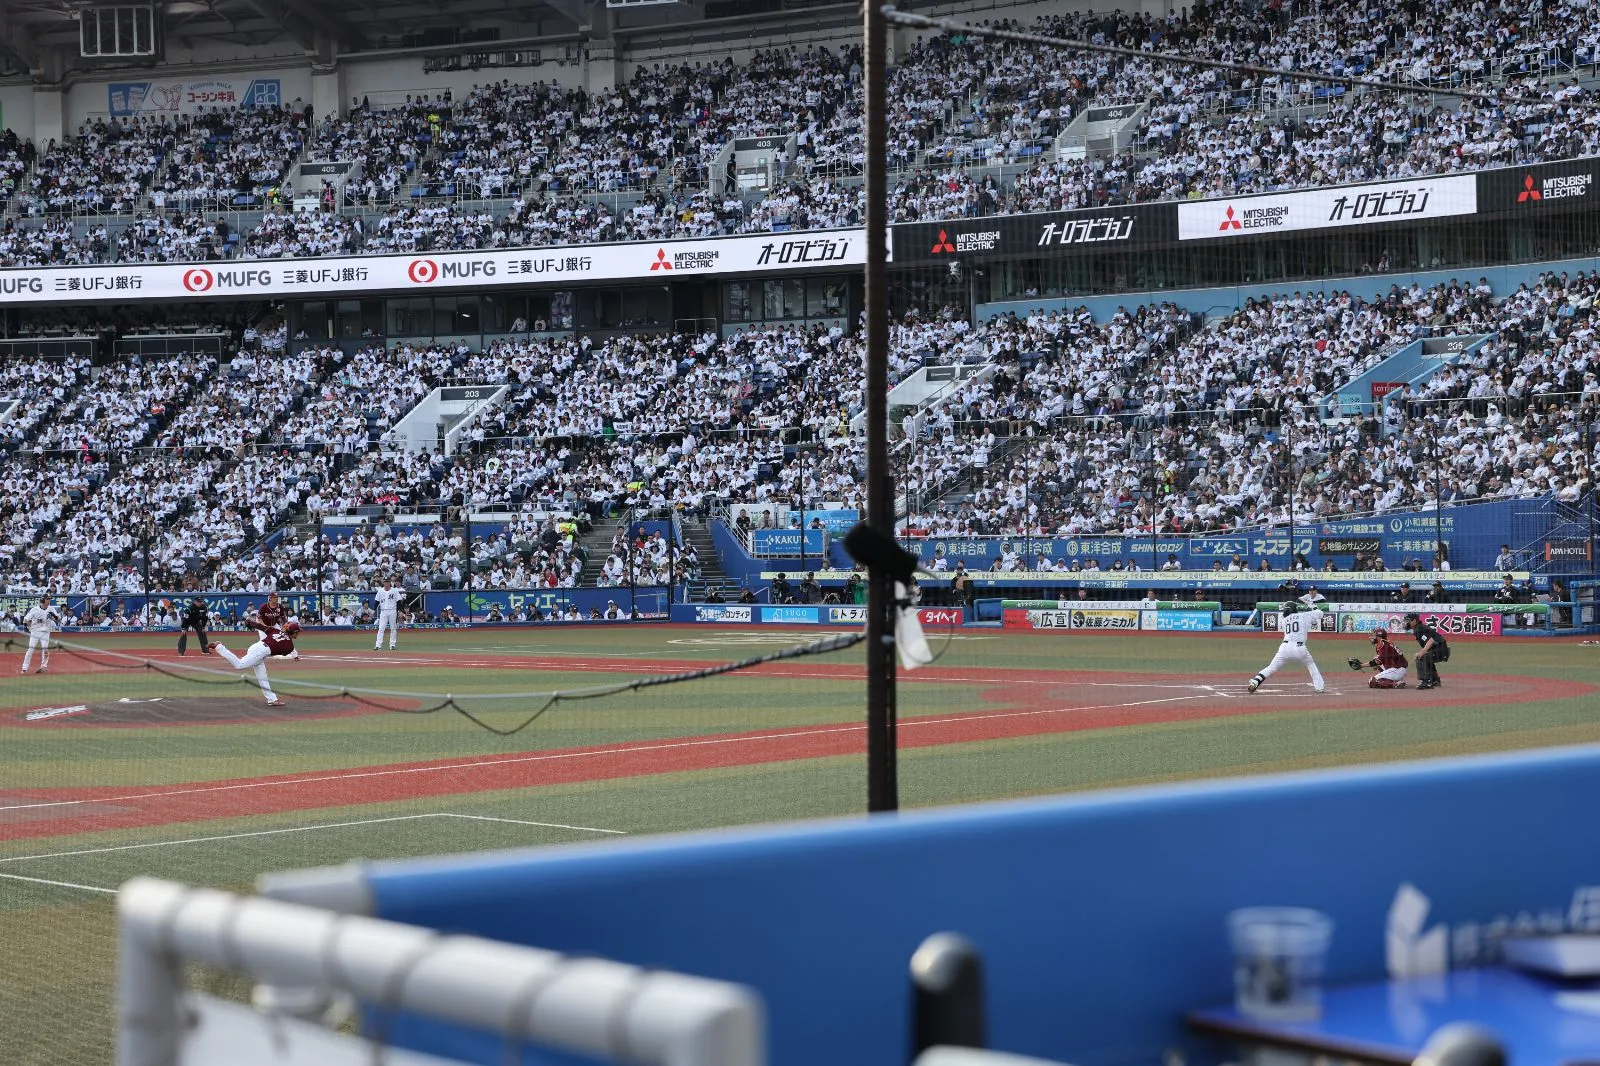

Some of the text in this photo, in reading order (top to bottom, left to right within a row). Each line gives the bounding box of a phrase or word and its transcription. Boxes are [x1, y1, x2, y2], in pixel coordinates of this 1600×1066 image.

[187, 91, 236, 102] コーシン牛乳
[1108, 110, 1123, 118] 404
[757, 140, 771, 148] 403
[1543, 174, 1592, 189] MITSUBISHI
[1543, 185, 1586, 199] ELECTRIC
[1329, 188, 1429, 221] オーロラビジョン
[1243, 206, 1289, 220] MITSUBISHI
[1243, 216, 1283, 228] ELECTRIC
[956, 230, 1000, 243] MITSUBISHI
[1038, 215, 1134, 246] オーロラビジョン
[757, 238, 849, 265] オーロラビジョン
[956, 240, 995, 252] ELECTRIC
[674, 250, 719, 261] MITSUBISHI
[442, 256, 592, 279] MUFG 三菱UFJ銀行
[674, 259, 714, 270] ELECTRIC
[0, 275, 143, 294] UFG 三菱UFJ銀行
[217, 267, 368, 288] MUFG 三菱UFJ銀行
[1447, 342, 1463, 350] 205
[464, 390, 480, 398] 203
[948, 542, 987, 556] 東洋合成
[1012, 541, 1053, 556] 東洋合成
[1080, 541, 1122, 555] 東洋合成
[1253, 538, 1313, 555] ネステック
[1564, 547, 1587, 555] HOTEL
[508, 592, 570, 609] センエー
[925, 611, 957, 623] タイヘイ
[1040, 612, 1067, 627] 広宣
[1085, 617, 1136, 628] 佐藤ケミカル
[1286, 621, 1299, 634] 00
[1425, 615, 1493, 634] さくら都市
